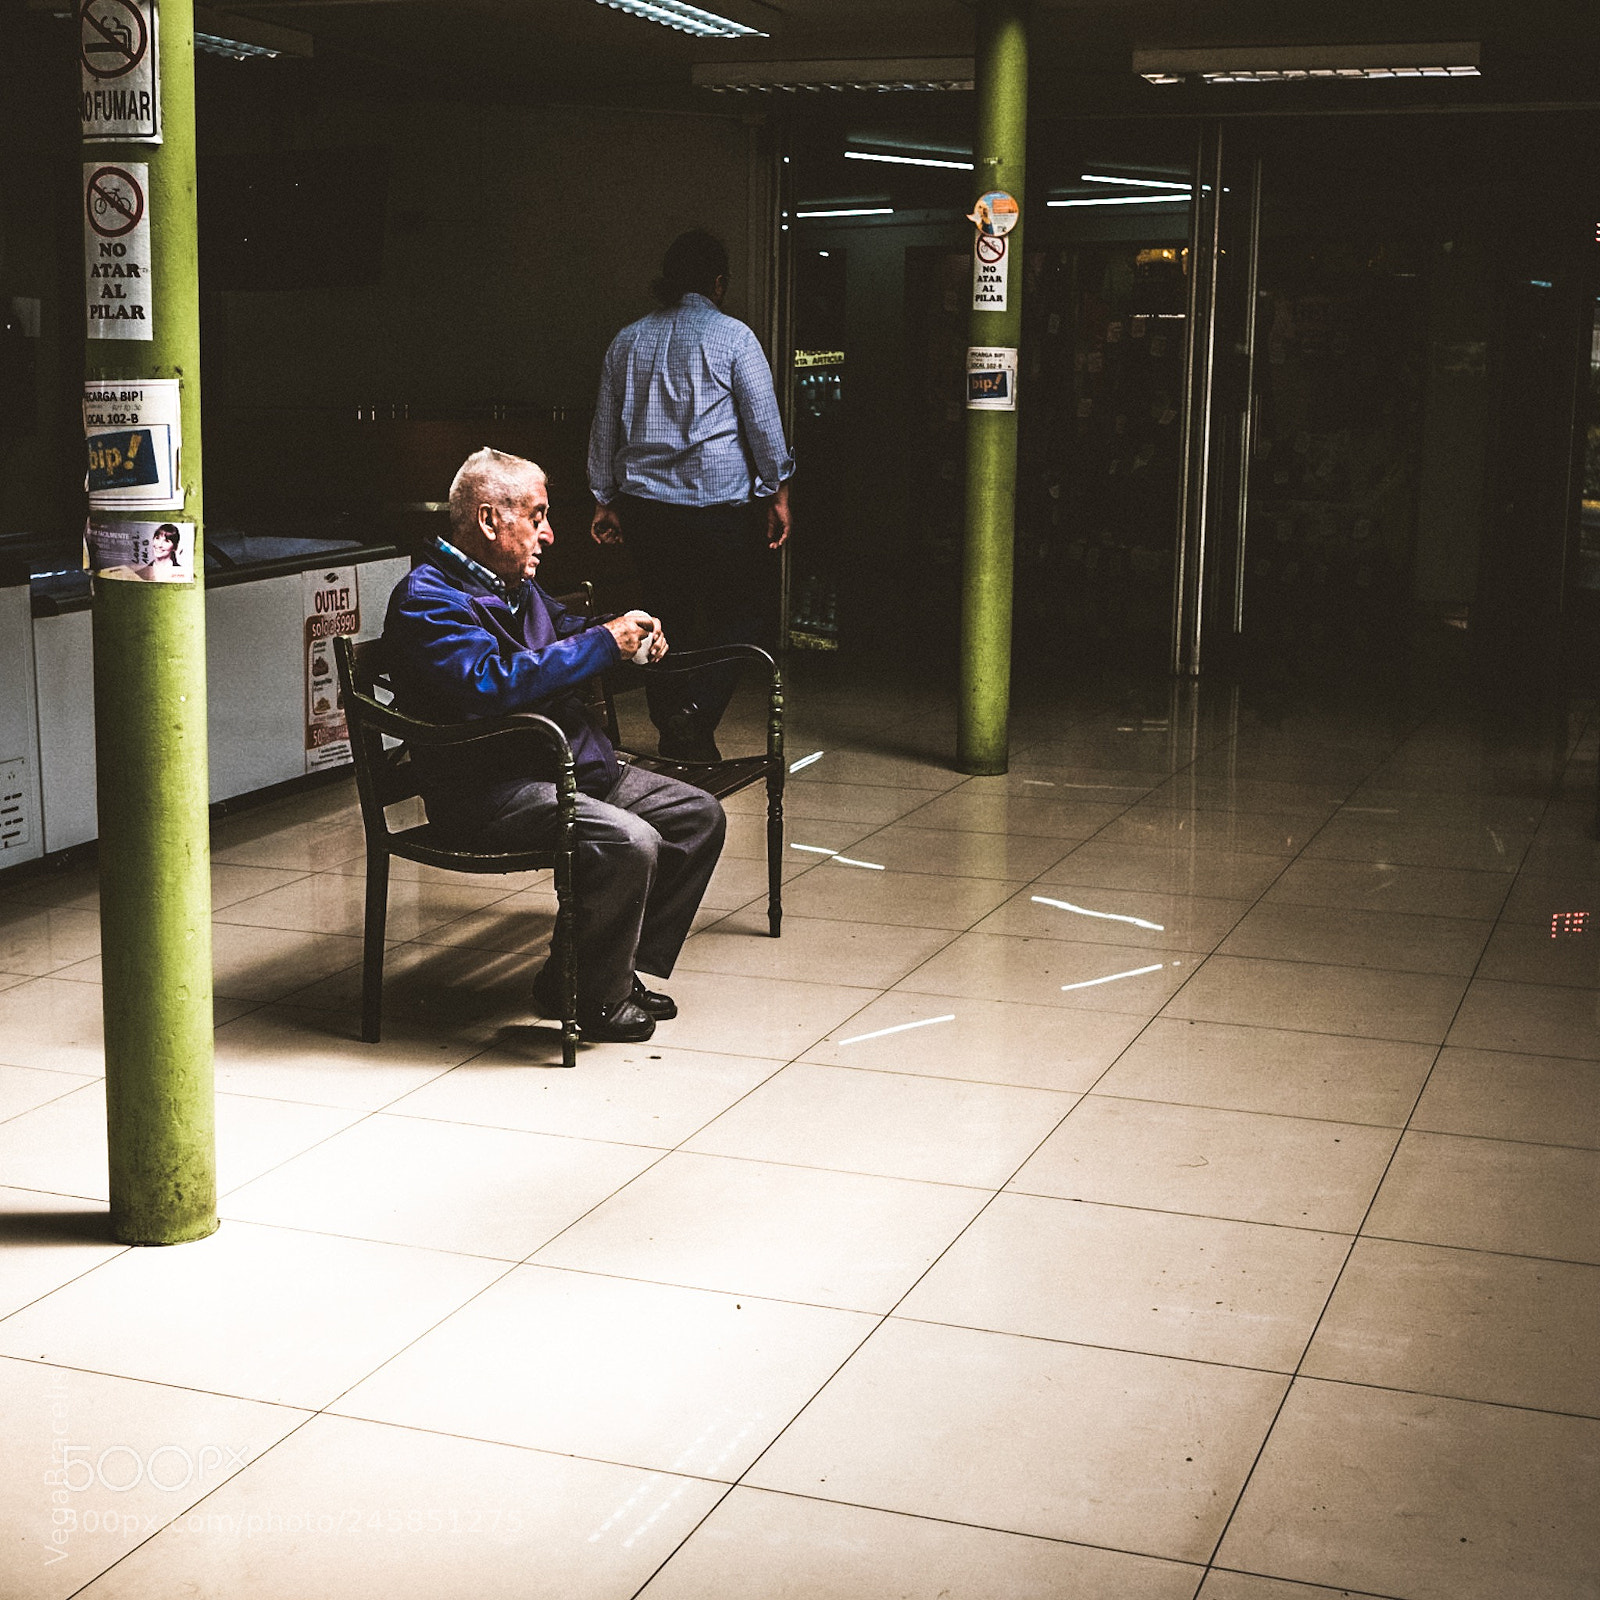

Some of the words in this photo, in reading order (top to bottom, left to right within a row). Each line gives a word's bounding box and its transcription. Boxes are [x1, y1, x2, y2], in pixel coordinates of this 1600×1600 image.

[94, 90, 150, 121] FUMAR
[99, 243, 127, 257] NO
[91, 263, 141, 278] ATAR
[983, 265, 996, 273] NO
[977, 275, 1002, 283] ATAR
[101, 284, 127, 299] AL
[982, 285, 995, 293] AL
[975, 294, 1003, 302] PILAR
[89, 304, 146, 320] PILAR
[120, 390, 143, 402] BIP!
[107, 413, 139, 424] 102-B
[89, 434, 142, 476] bip!
[315, 588, 350, 614] OUTLET
[312, 617, 328, 637] solo
[335, 612, 356, 634] $990
